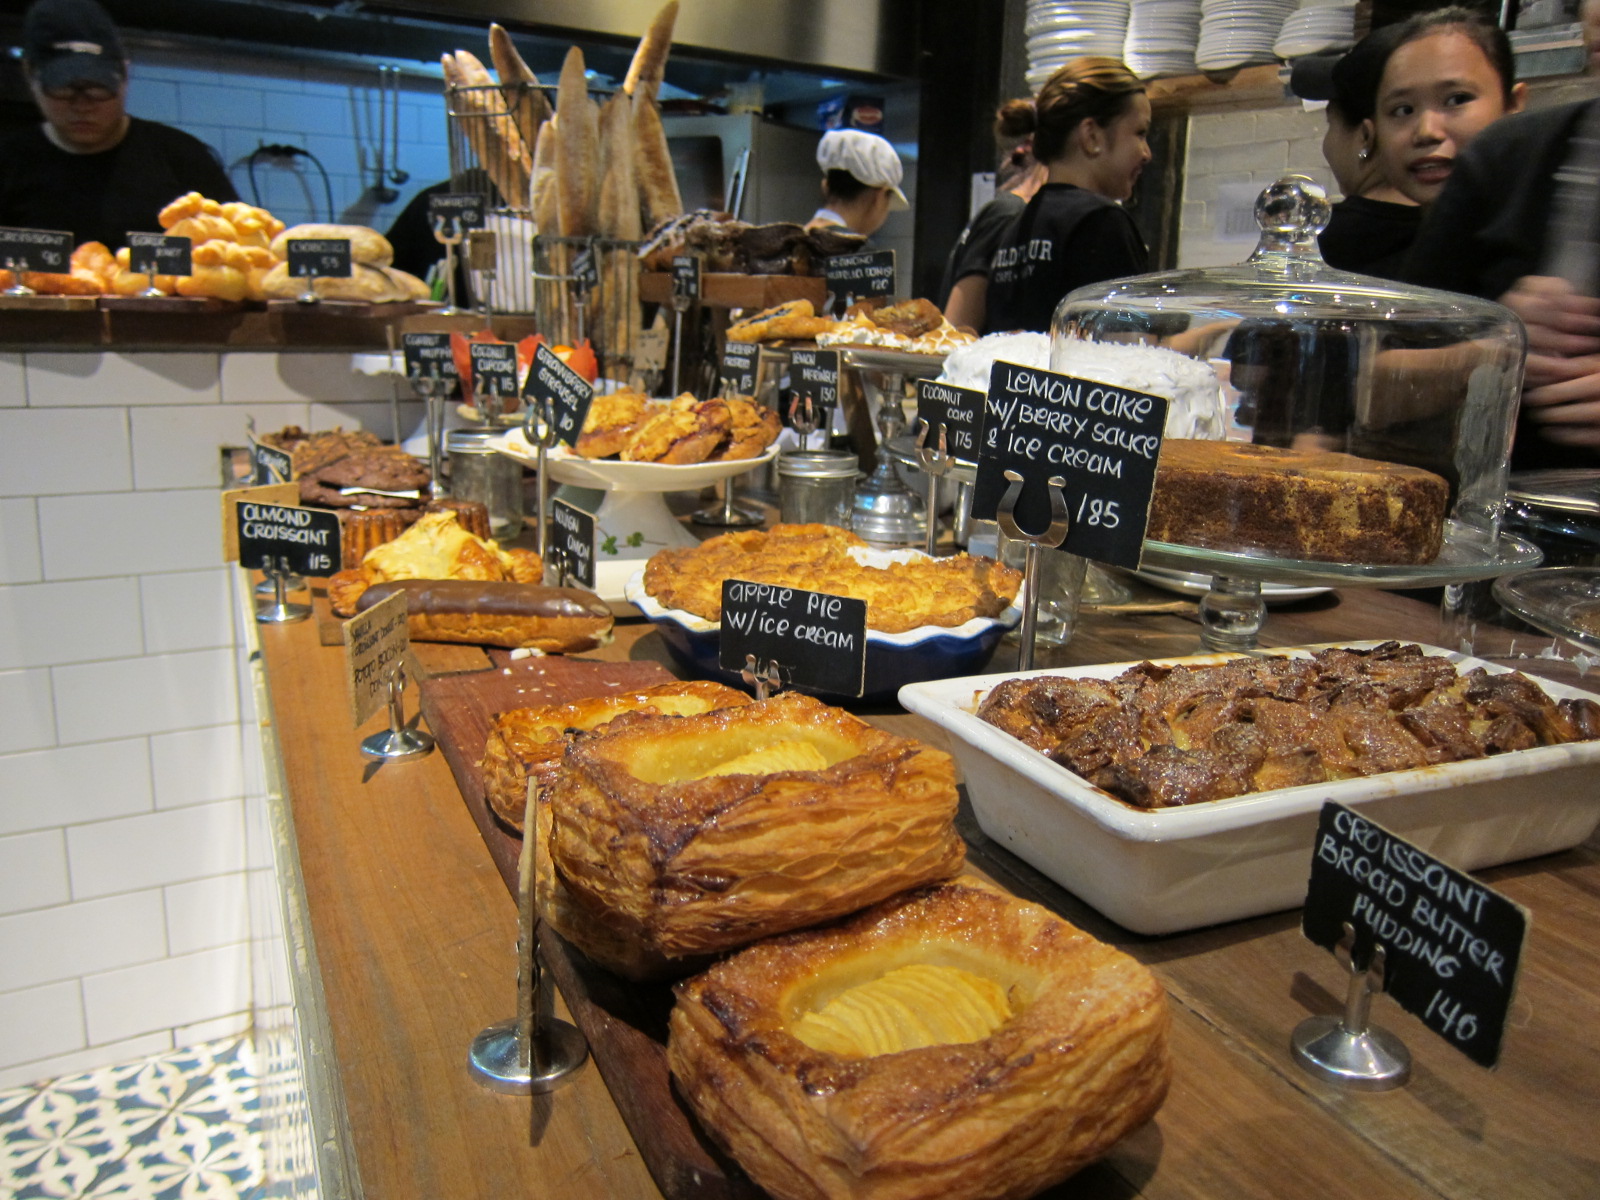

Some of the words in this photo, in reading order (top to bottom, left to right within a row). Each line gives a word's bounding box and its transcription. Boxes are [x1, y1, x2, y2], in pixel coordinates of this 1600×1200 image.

[502, 377, 514, 391] 115
[821, 386, 836, 402] 130
[922, 384, 963, 406] COCONUT
[955, 430, 973, 449] 175
[987, 427, 998, 448] &
[1076, 492, 1120, 528] 185
[309, 552, 332, 570] 115
[1352, 893, 1461, 978] PUDDING
